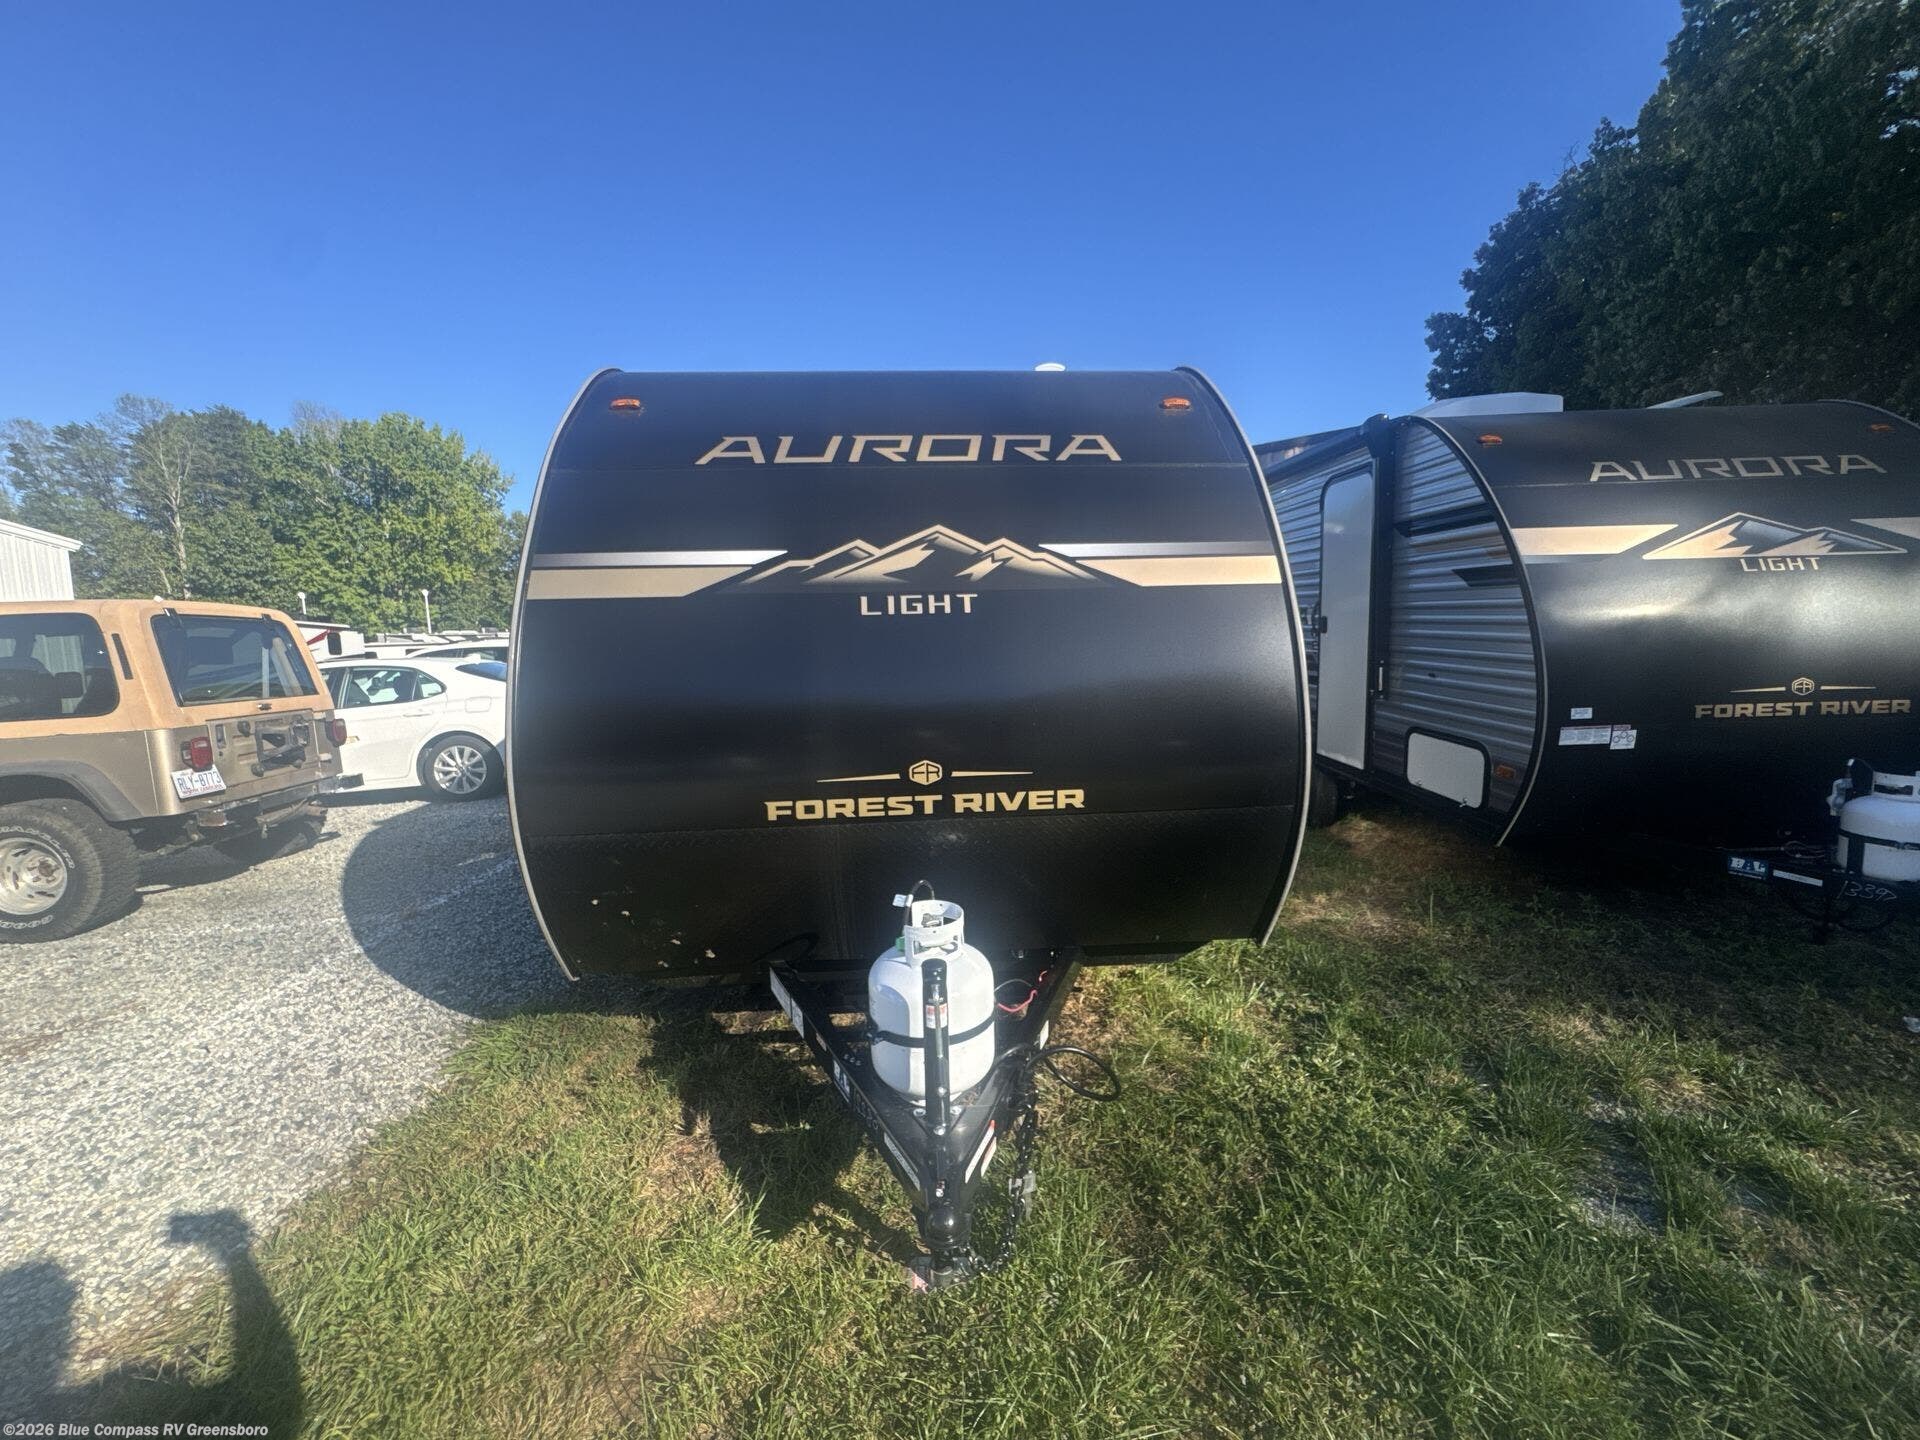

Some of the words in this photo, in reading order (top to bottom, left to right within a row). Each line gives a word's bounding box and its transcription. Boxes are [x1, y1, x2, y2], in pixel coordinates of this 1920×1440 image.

[695, 434, 1122, 465] AURORA
[1590, 454, 1887, 482] AURORA
[1740, 557, 1820, 572] LIGHT
[860, 593, 978, 616] LIGHT
[1694, 701, 1813, 719] FOREST
[1820, 699, 1911, 715] RIVER
[764, 794, 942, 821] FOREST
[952, 789, 1085, 814] RIVER
